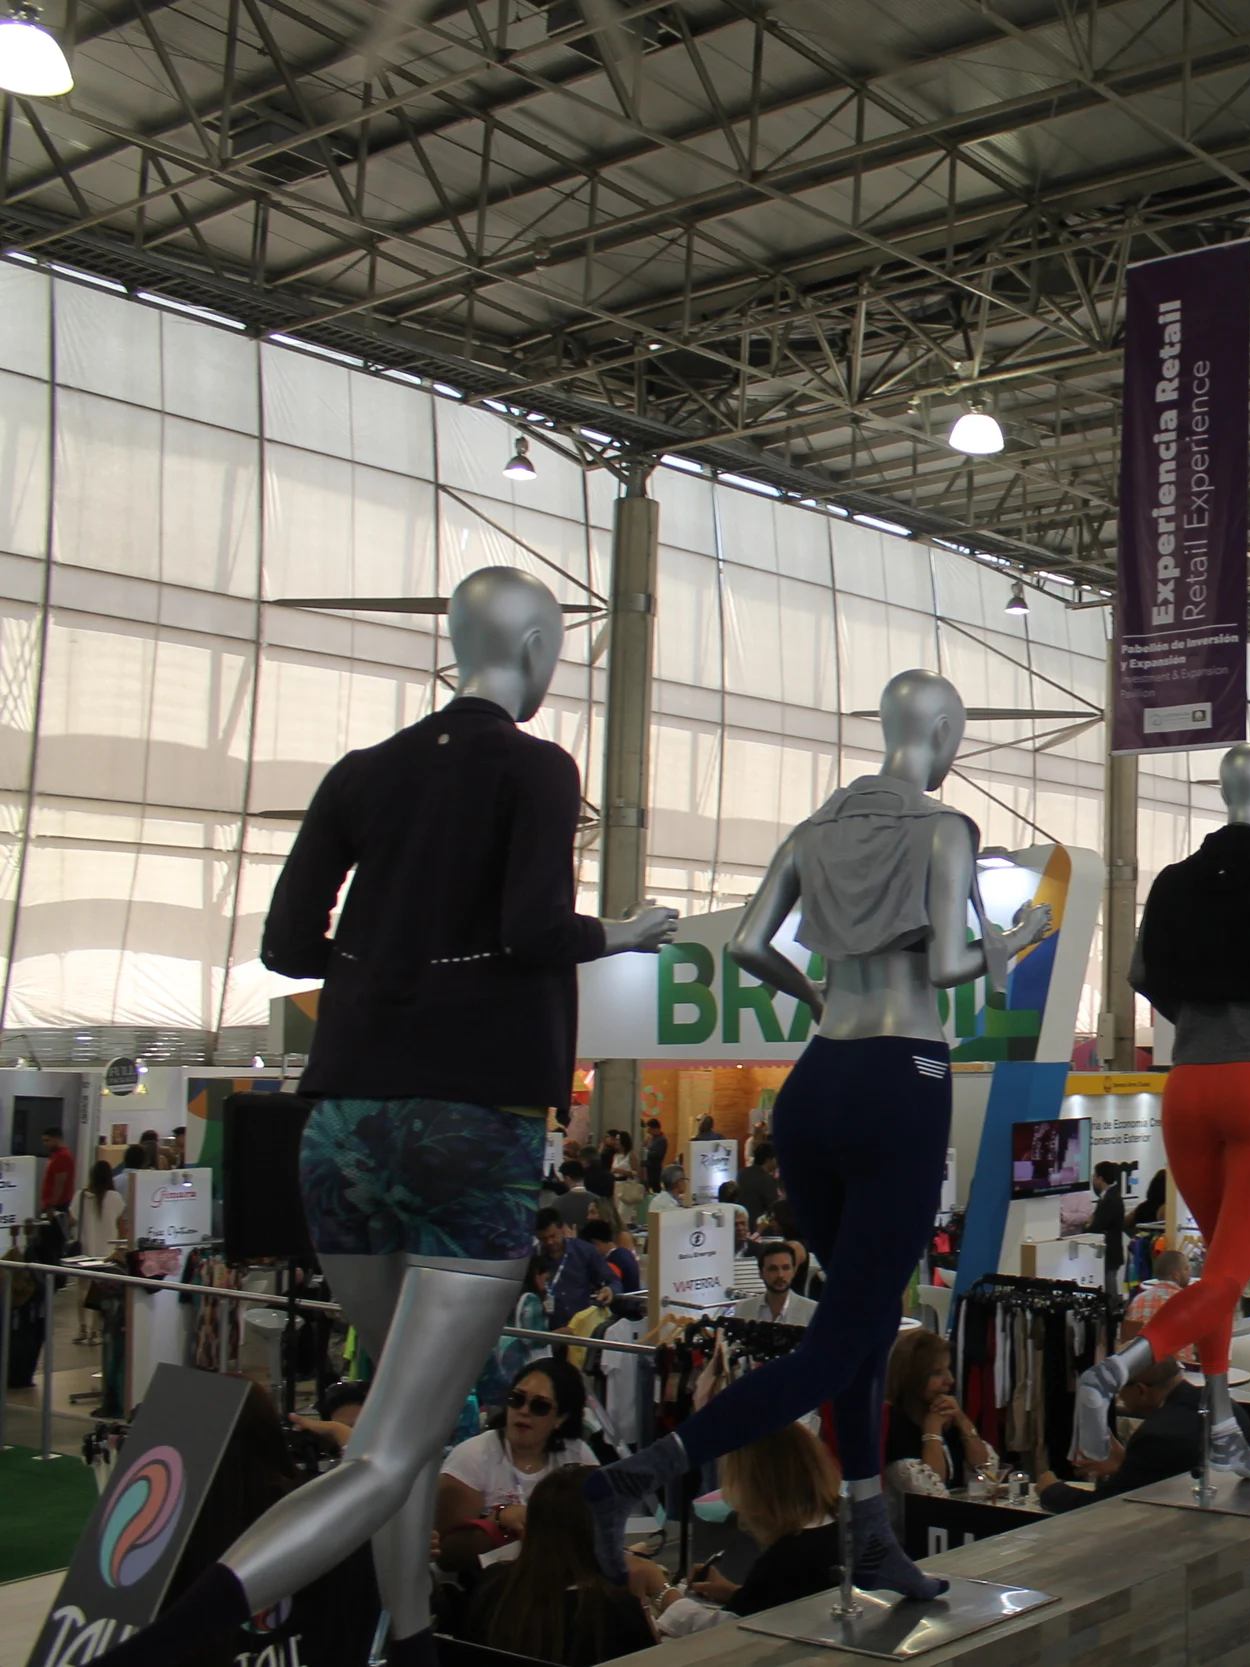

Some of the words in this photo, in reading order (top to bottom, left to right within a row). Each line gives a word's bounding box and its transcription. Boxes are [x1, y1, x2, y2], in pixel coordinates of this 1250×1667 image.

[1155, 299, 1182, 403] Retail
[1183, 359, 1215, 529] Experience
[1151, 409, 1181, 626] Experiencia
[1182, 539, 1208, 621] Retail
[1121, 643, 1169, 655] Pabellón
[1170, 640, 1185, 650] de
[1186, 634, 1239, 648] Inversión
[1129, 655, 1186, 669] Expansión
